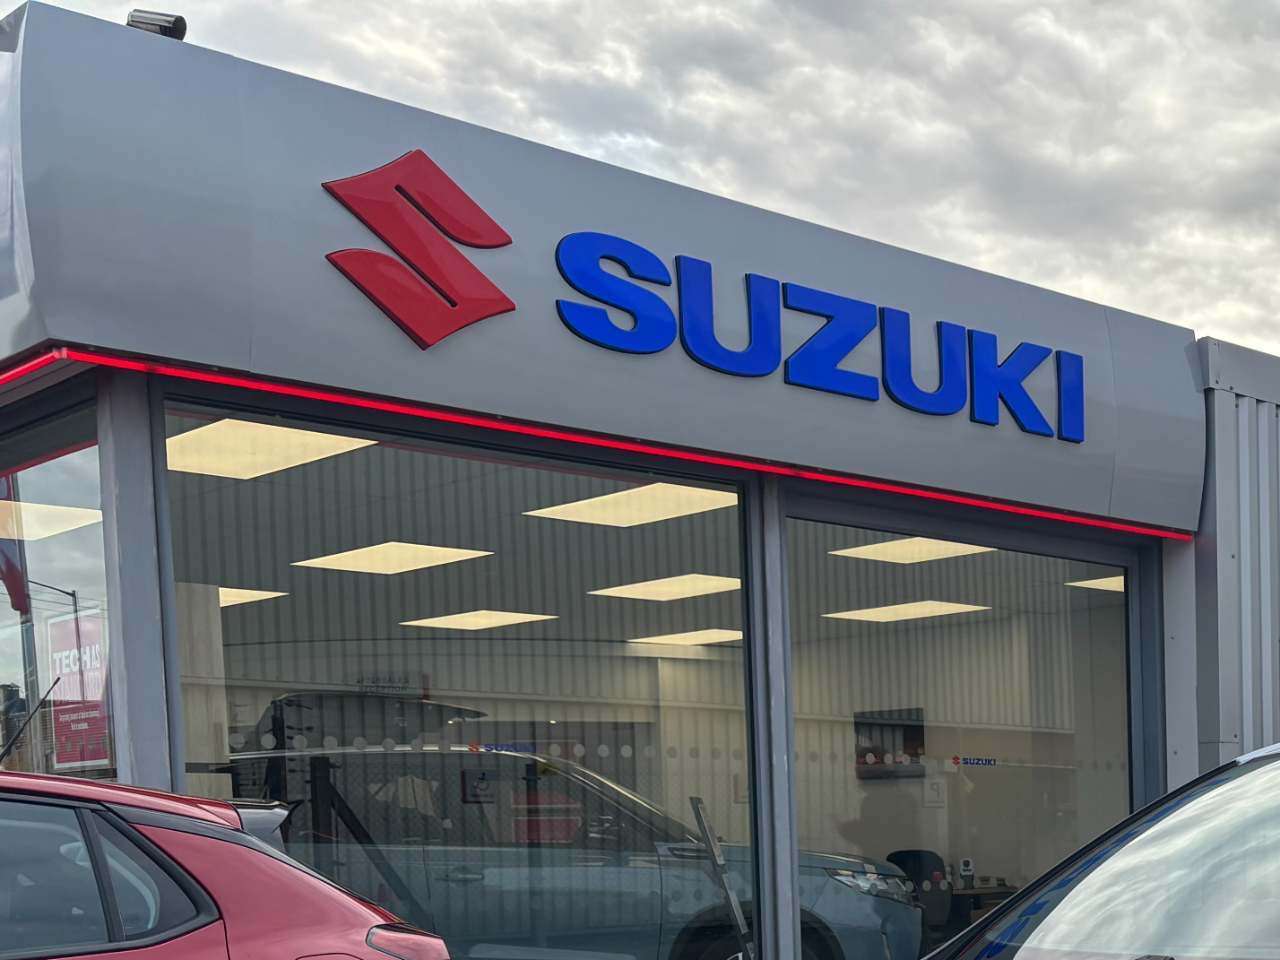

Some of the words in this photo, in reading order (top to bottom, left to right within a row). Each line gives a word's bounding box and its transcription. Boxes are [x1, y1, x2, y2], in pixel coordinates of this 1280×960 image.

[555, 231, 1085, 444] SUZUKI
[53, 647, 89, 675] TECH
[962, 757, 996, 766] SUZUKI
